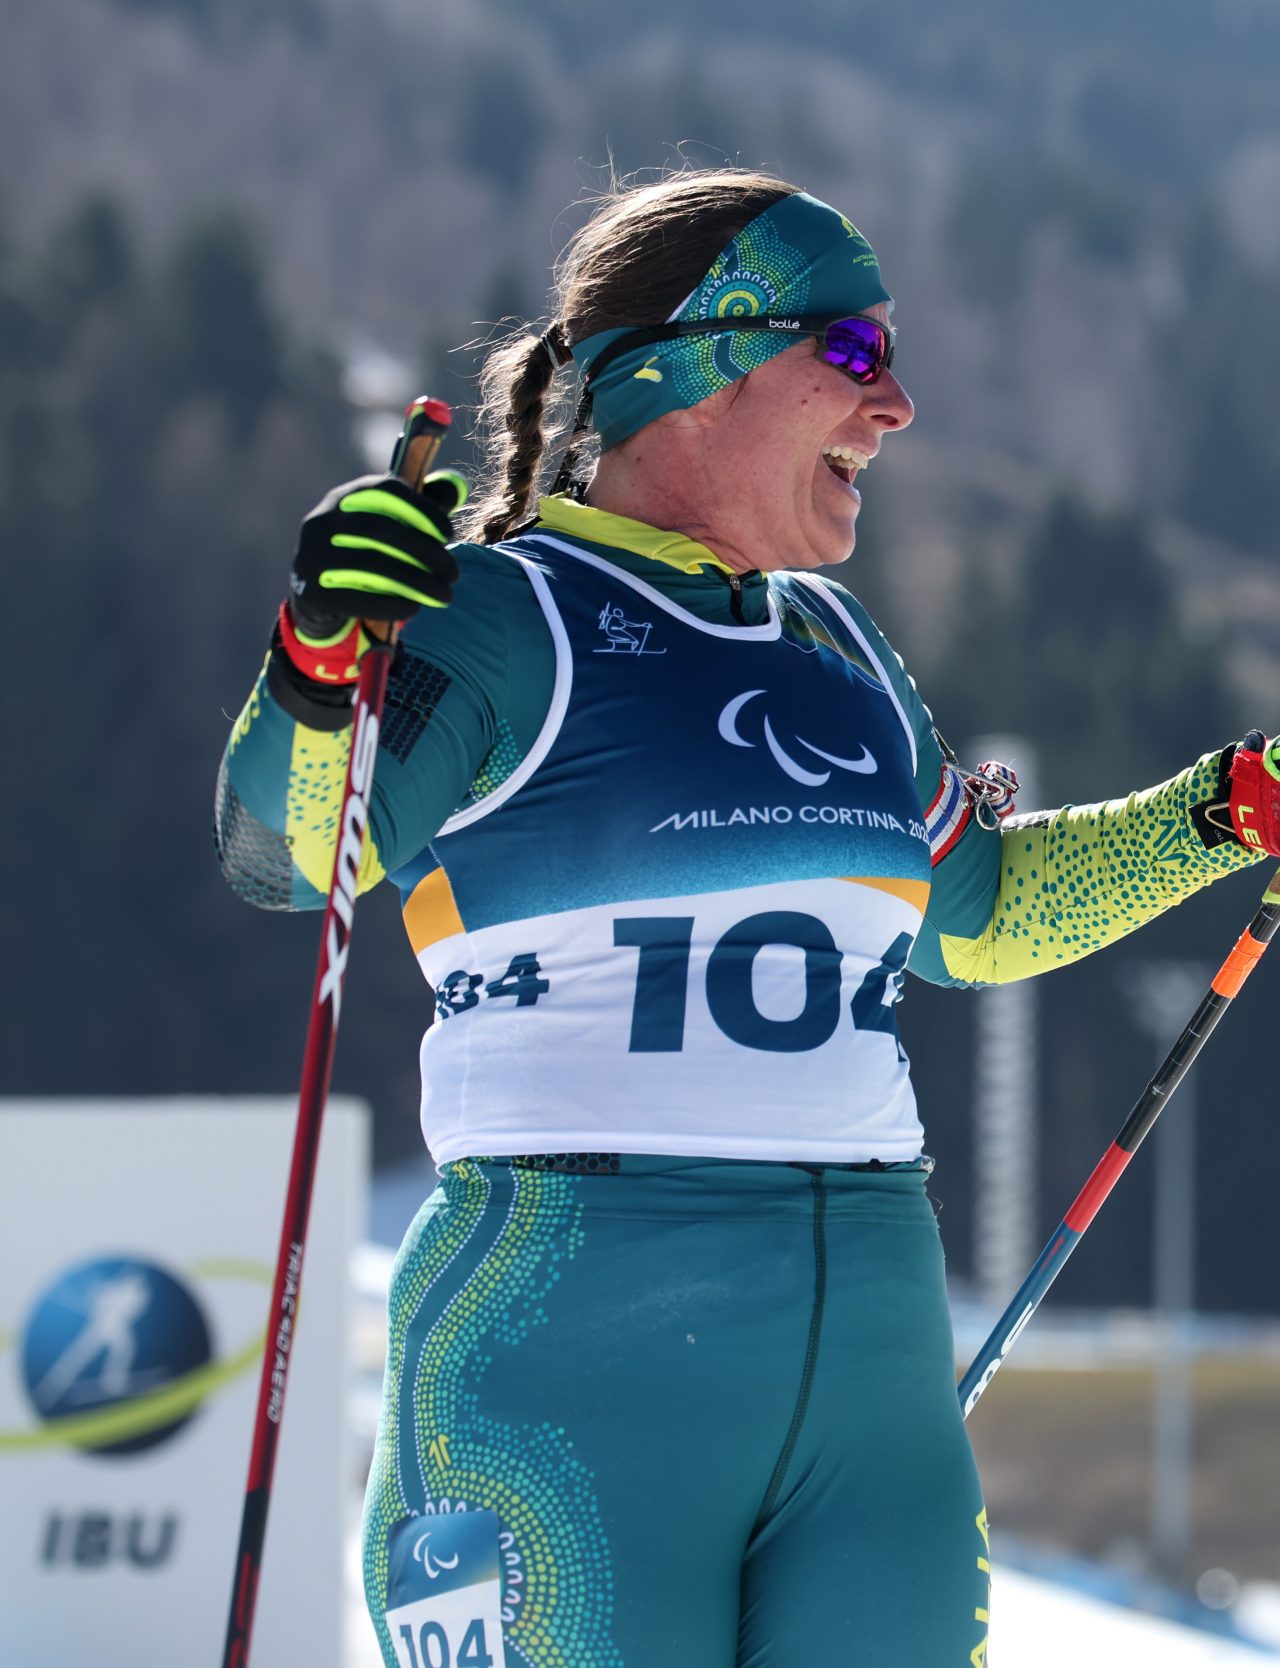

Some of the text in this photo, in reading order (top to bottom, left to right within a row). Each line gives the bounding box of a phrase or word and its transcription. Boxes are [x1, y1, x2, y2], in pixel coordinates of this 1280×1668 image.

[315, 664, 360, 680] LE
[649, 805, 793, 832] MILANO
[799, 806, 905, 833] CORTINA
[1237, 804, 1266, 853] LE
[319, 687, 379, 1028] SWIX
[435, 952, 550, 1020] 04
[41, 1508, 180, 1571] IBU
[399, 1618, 494, 1668] 104
